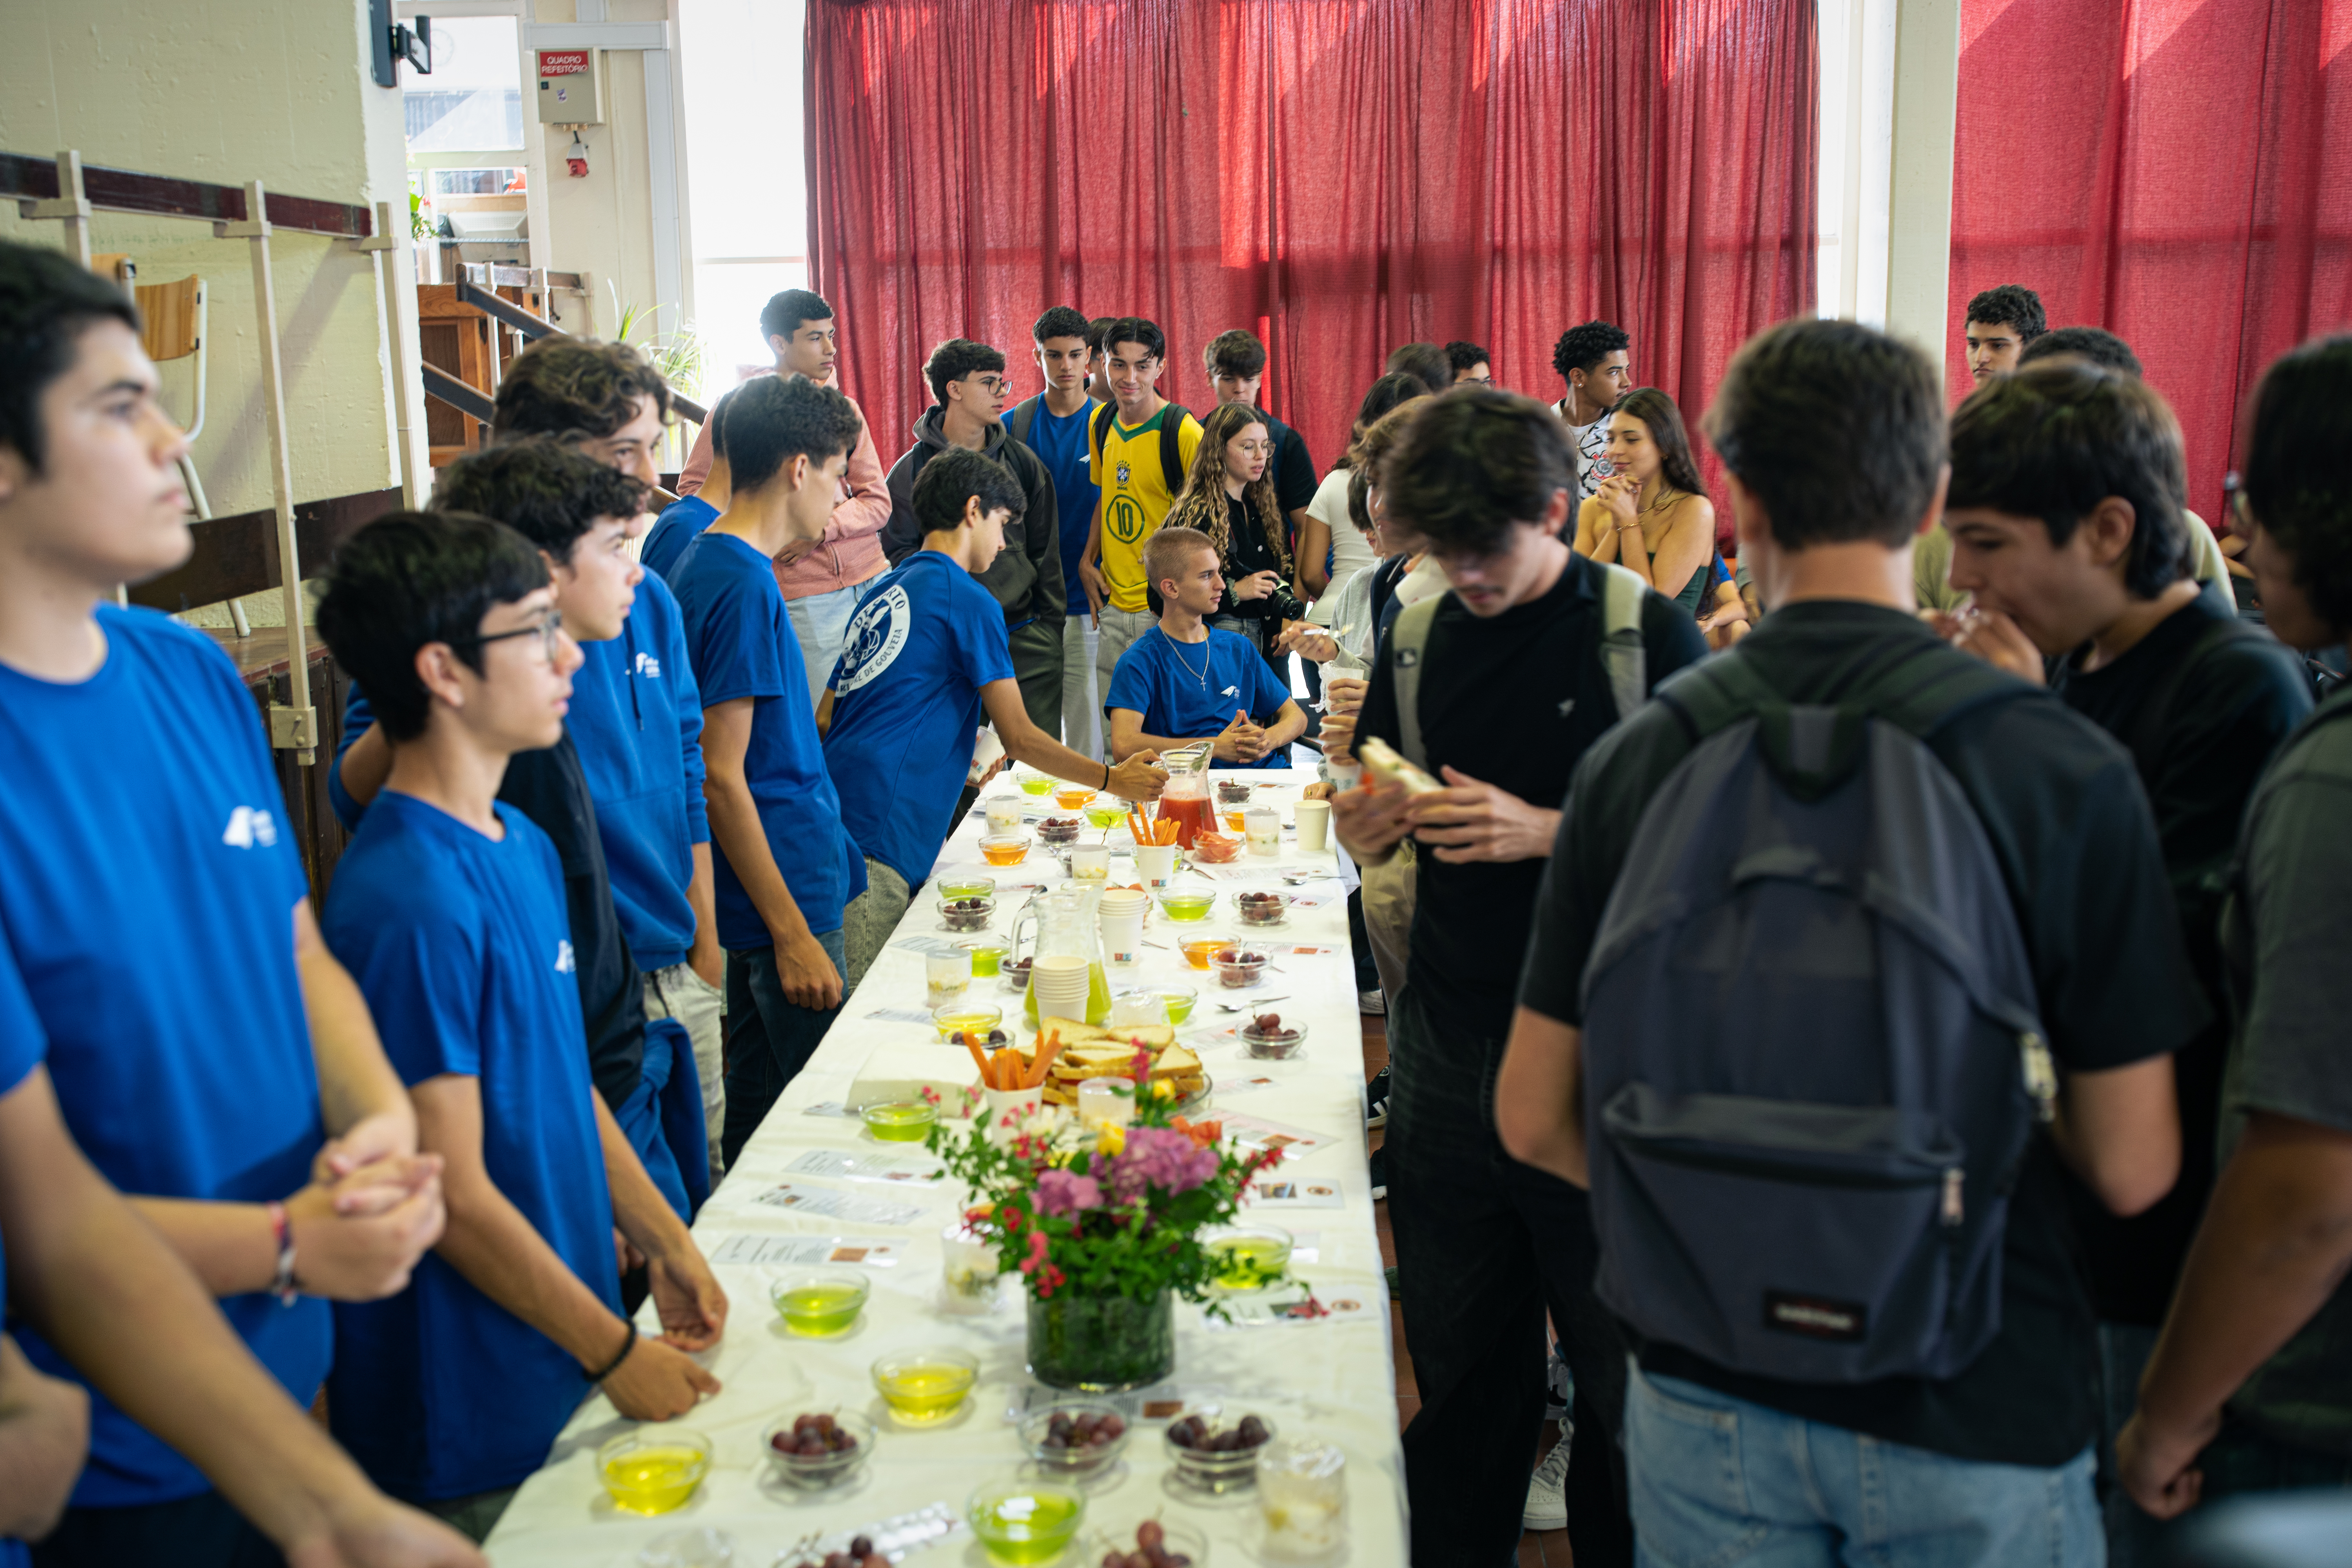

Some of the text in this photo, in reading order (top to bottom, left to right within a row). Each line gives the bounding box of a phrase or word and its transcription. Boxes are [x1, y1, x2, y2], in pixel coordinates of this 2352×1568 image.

[542, 63, 588, 74] REFEITÓRIO
[547, 56, 582, 65] QUADRO
[1116, 502, 1133, 536] 10
[864, 628, 903, 677] DE GOUVEIA
